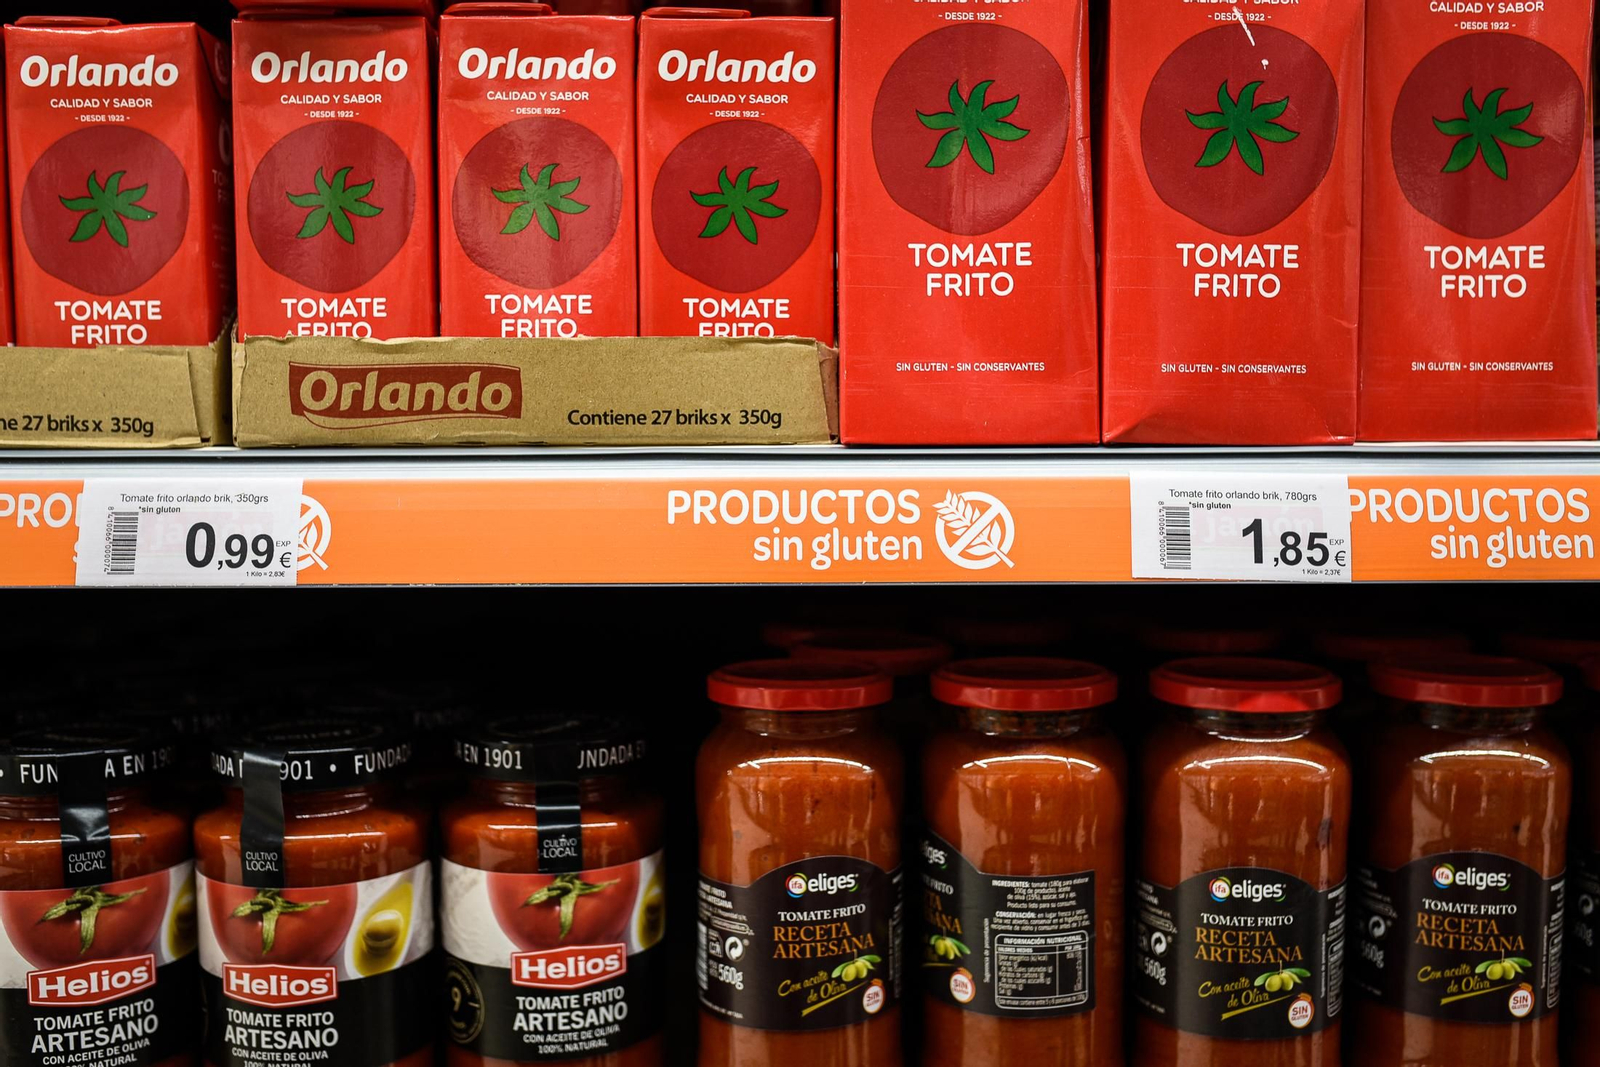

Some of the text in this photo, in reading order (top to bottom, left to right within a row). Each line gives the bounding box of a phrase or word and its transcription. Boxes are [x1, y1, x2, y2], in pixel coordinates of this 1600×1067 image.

[945, 12, 996, 20] DESDE 1922
[1214, 12, 1243, 20] DESDE
[1429, 1, 1545, 13] CALIDAD Y SABOR
[1460, 22, 1510, 30] DESDE 1922
[20, 54, 180, 87] Orlando
[250, 51, 409, 84] Orlando
[457, 47, 617, 80] Orlando
[658, 49, 817, 83] Orlando
[50, 98, 153, 109] CALIDAD Y SABOR
[280, 93, 382, 104] CALIDAD Y SABOR
[487, 91, 589, 102] CALIDAD Y SABOR
[686, 94, 789, 104] CALIDAD Y SABOR
[80, 114, 125, 122] DESDE 1922
[310, 110, 354, 118] DESDE 1922
[516, 107, 560, 115] DESDE 1922
[715, 110, 759, 118] DESDE 1922
[908, 242, 1032, 268] TOMATE
[1176, 243, 1300, 269] TOMATE
[1424, 245, 1546, 270] TOMATE
[926, 271, 1014, 297] FRITO
[1194, 273, 1281, 299] FRITO
[1441, 274, 1528, 299] FRITO
[54, 300, 162, 322] TOMATE
[280, 298, 388, 319] TOMATE
[484, 294, 593, 316] TOMATE
[682, 298, 791, 319] TOMATE
[71, 324, 148, 345] FRITO
[501, 318, 578, 338] FRITO
[698, 322, 776, 338] FRITO
[896, 361, 1045, 373] SIN GLUTEN SIN CONSERVANTES
[1161, 363, 1307, 375] SIN GLUTEN SIN CONSERVANTES
[1411, 361, 1554, 373] SIN GLUTEN SIN CONSERVANTES
[299, 370, 512, 412] Orlando
[22, 415, 44, 432] 27
[47, 414, 90, 433] briks
[92, 420, 103, 432] x
[111, 416, 154, 437] 350g
[567, 408, 782, 429] Contiene 27 briks x 350g
[120, 493, 154, 502] Tomate
[156, 493, 173, 502] frito
[177, 493, 211, 503] orlando
[236, 493, 269, 504] 350grs
[1169, 489, 1203, 498] Tomate
[1206, 489, 1223, 498] frito
[1225, 489, 1260, 499] orlando
[1285, 492, 1317, 502] 780grs
[1206, 501, 1231, 510] gluten
[1350, 487, 1590, 524] PRODUCTOS
[156, 506, 181, 515] gluten
[667, 489, 920, 525] PRODUCTOS
[185, 521, 275, 570] 0,99
[752, 526, 922, 570] sin gluten
[1242, 518, 1330, 567] 1,85
[1329, 538, 1344, 546] EXP
[1430, 525, 1594, 568] sin gluten
[123, 755, 145, 775] EN
[484, 748, 522, 770] 1901
[543, 837, 577, 849] CULTIVO
[543, 846, 578, 859] LOCAL
[69, 850, 106, 863] CULTIVO
[245, 851, 278, 861] CULTIVO
[246, 861, 279, 871] LOCAL
[69, 860, 107, 874] LOCAL
[807, 873, 856, 894] eliges
[1455, 867, 1507, 890] eliges
[1232, 880, 1282, 902] eliges
[778, 903, 866, 922] TOMATE FRITO
[1422, 898, 1517, 915] TOMATE FRITO
[1200, 913, 1293, 927] TOMATE FRITO
[1416, 912, 1499, 935] RECETA
[773, 921, 852, 941] RECETA
[1195, 927, 1277, 946] RECETA
[1415, 929, 1525, 952] ARTESANA
[772, 933, 875, 958] ARTESANA
[1194, 944, 1303, 964] ARTESANA
[520, 953, 620, 980] Helios
[1417, 963, 1471, 982] Con aceite
[37, 965, 149, 999] Helios
[229, 970, 329, 997] Helios
[1198, 977, 1250, 998] Con aceite
[1461, 976, 1490, 992] Oliva
[516, 986, 625, 1011] TOMATE FRITO
[1241, 989, 1269, 1006] Oliva
[1512, 994, 1528, 1005] SIN
[34, 998, 155, 1031] TOMATE FRITO
[226, 1007, 335, 1028] TOMATE FRITO
[513, 1001, 628, 1031] ARTESANO
[1292, 1005, 1308, 1016] SIN
[31, 1014, 159, 1054] ARTESANO
[224, 1024, 339, 1050] ARTESANO
[42, 1037, 151, 1066] CON ACEITE DE OLIVA
[232, 1047, 329, 1061] CON ACEITE DE OLIVA
